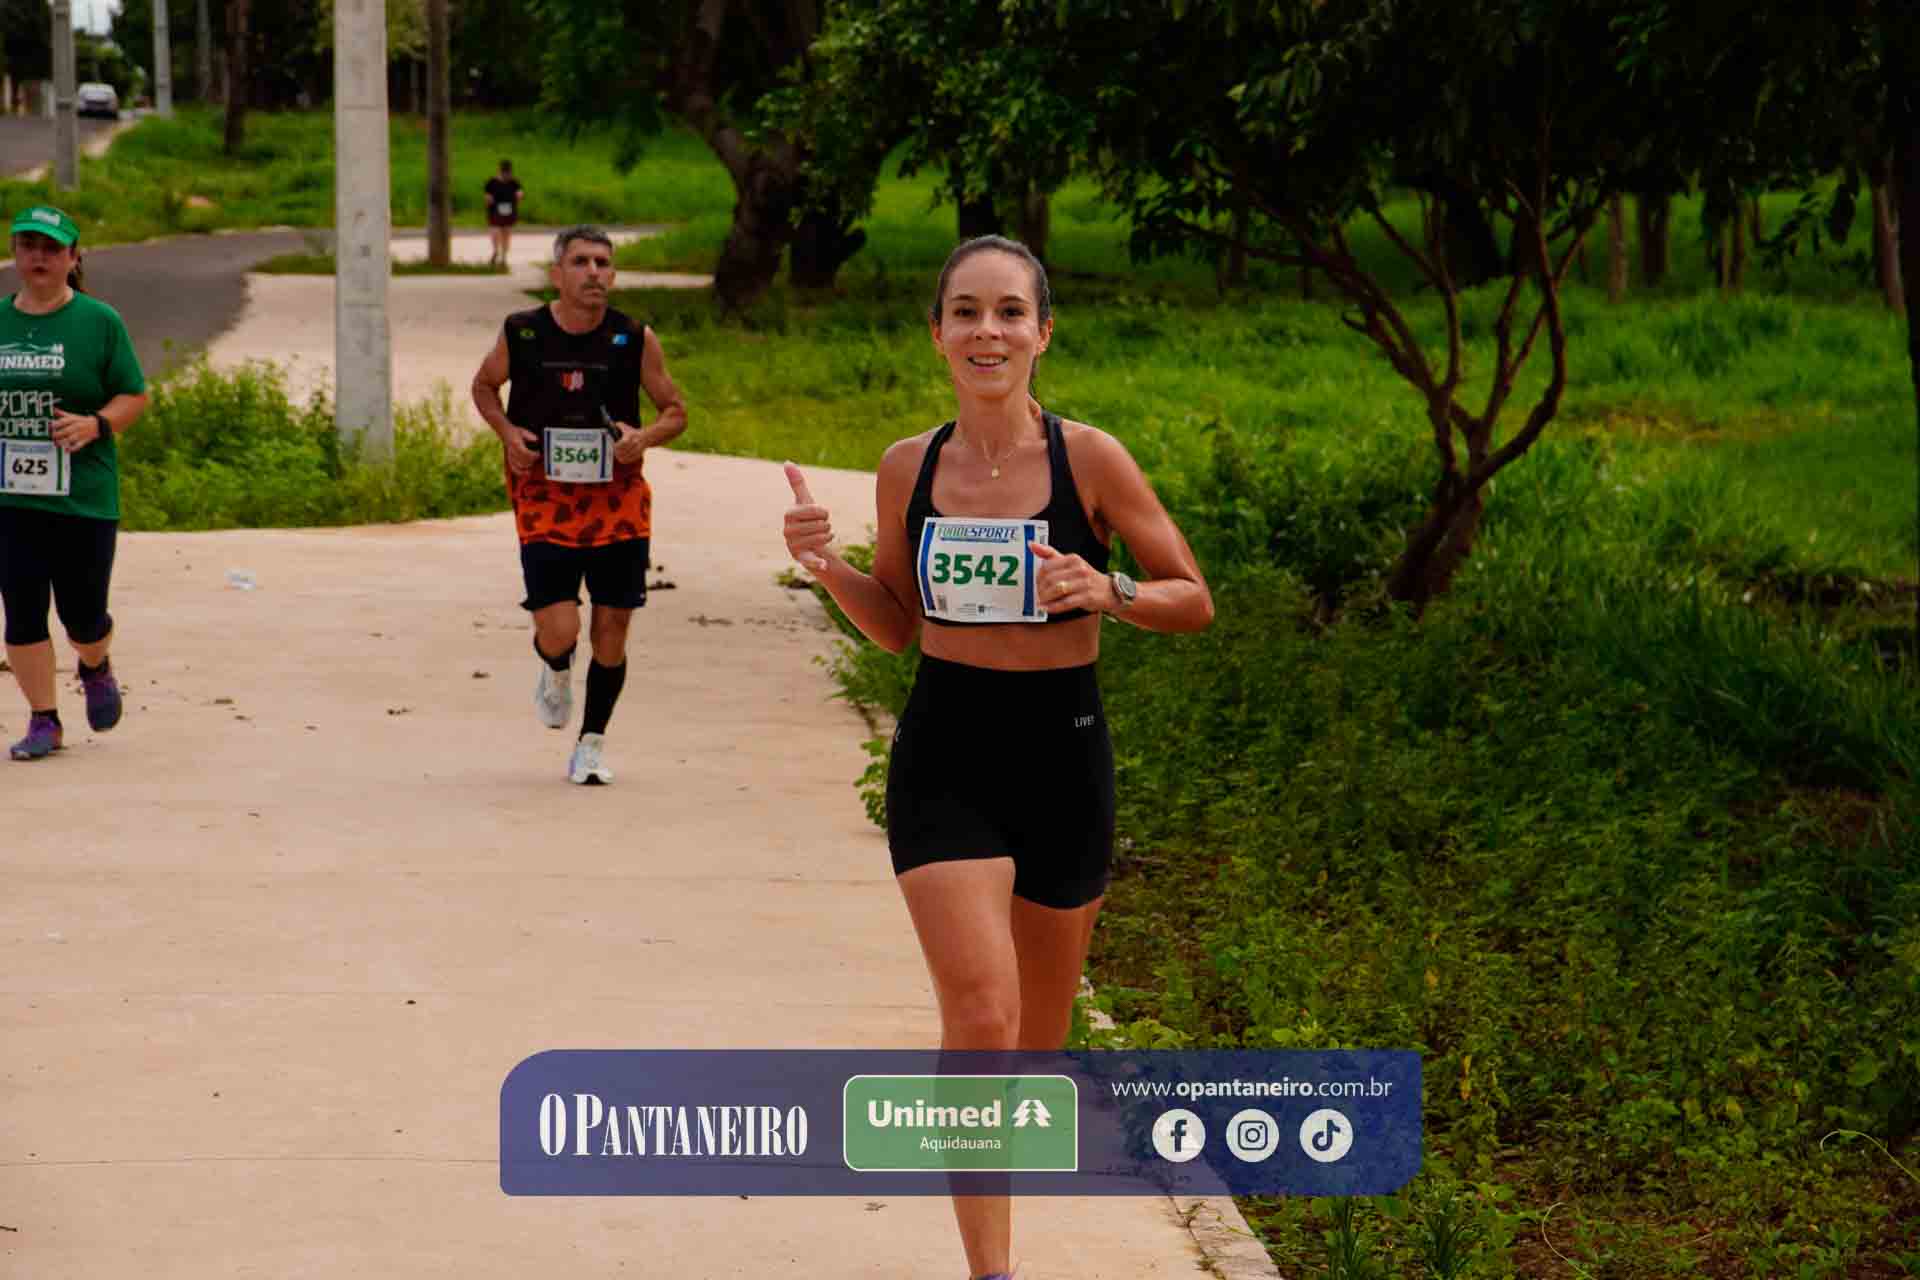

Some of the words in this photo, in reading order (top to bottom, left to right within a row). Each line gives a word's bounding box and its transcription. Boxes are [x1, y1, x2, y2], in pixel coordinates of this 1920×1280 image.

[553, 446, 599, 463] 3564
[12, 458, 48, 475] 625
[932, 553, 1019, 586] 3542
